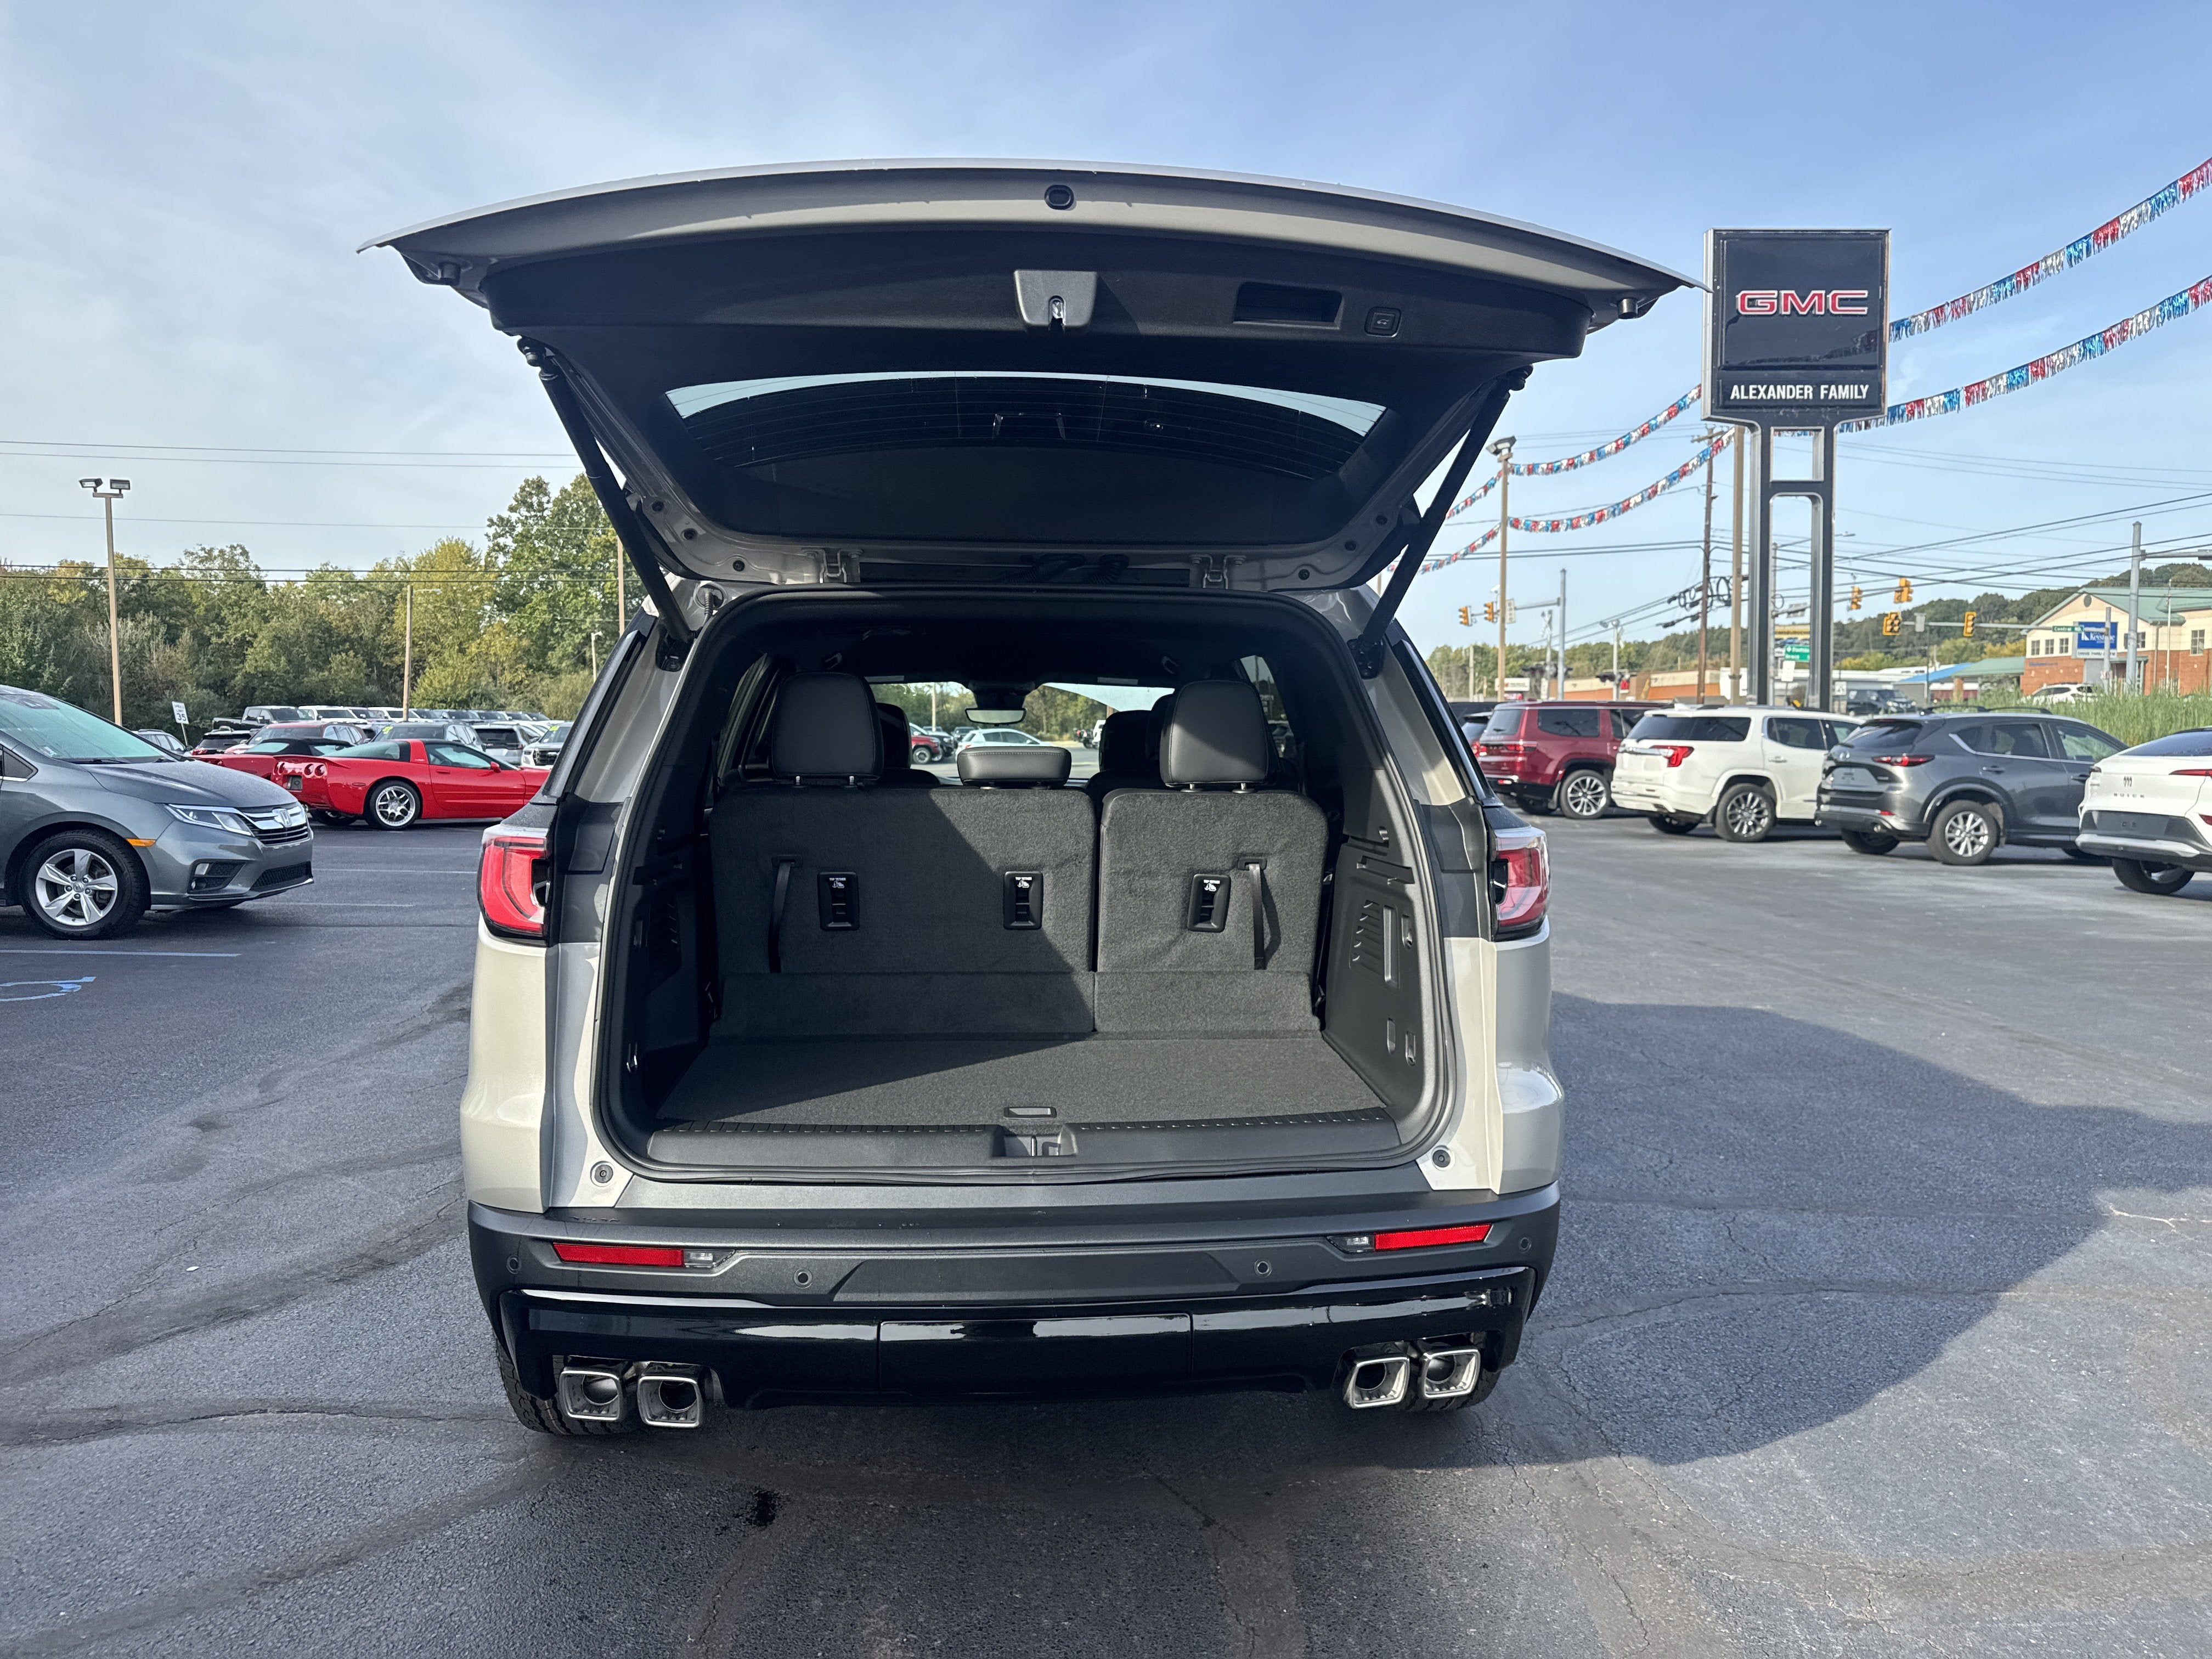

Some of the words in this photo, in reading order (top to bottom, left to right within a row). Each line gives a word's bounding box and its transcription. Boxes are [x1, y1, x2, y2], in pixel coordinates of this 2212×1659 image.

[1736, 290, 1868, 315] GMC
[1730, 385, 1813, 400] ALEXANDER
[1820, 385, 1869, 400] FAMILY
[177, 713, 187, 721] 35
